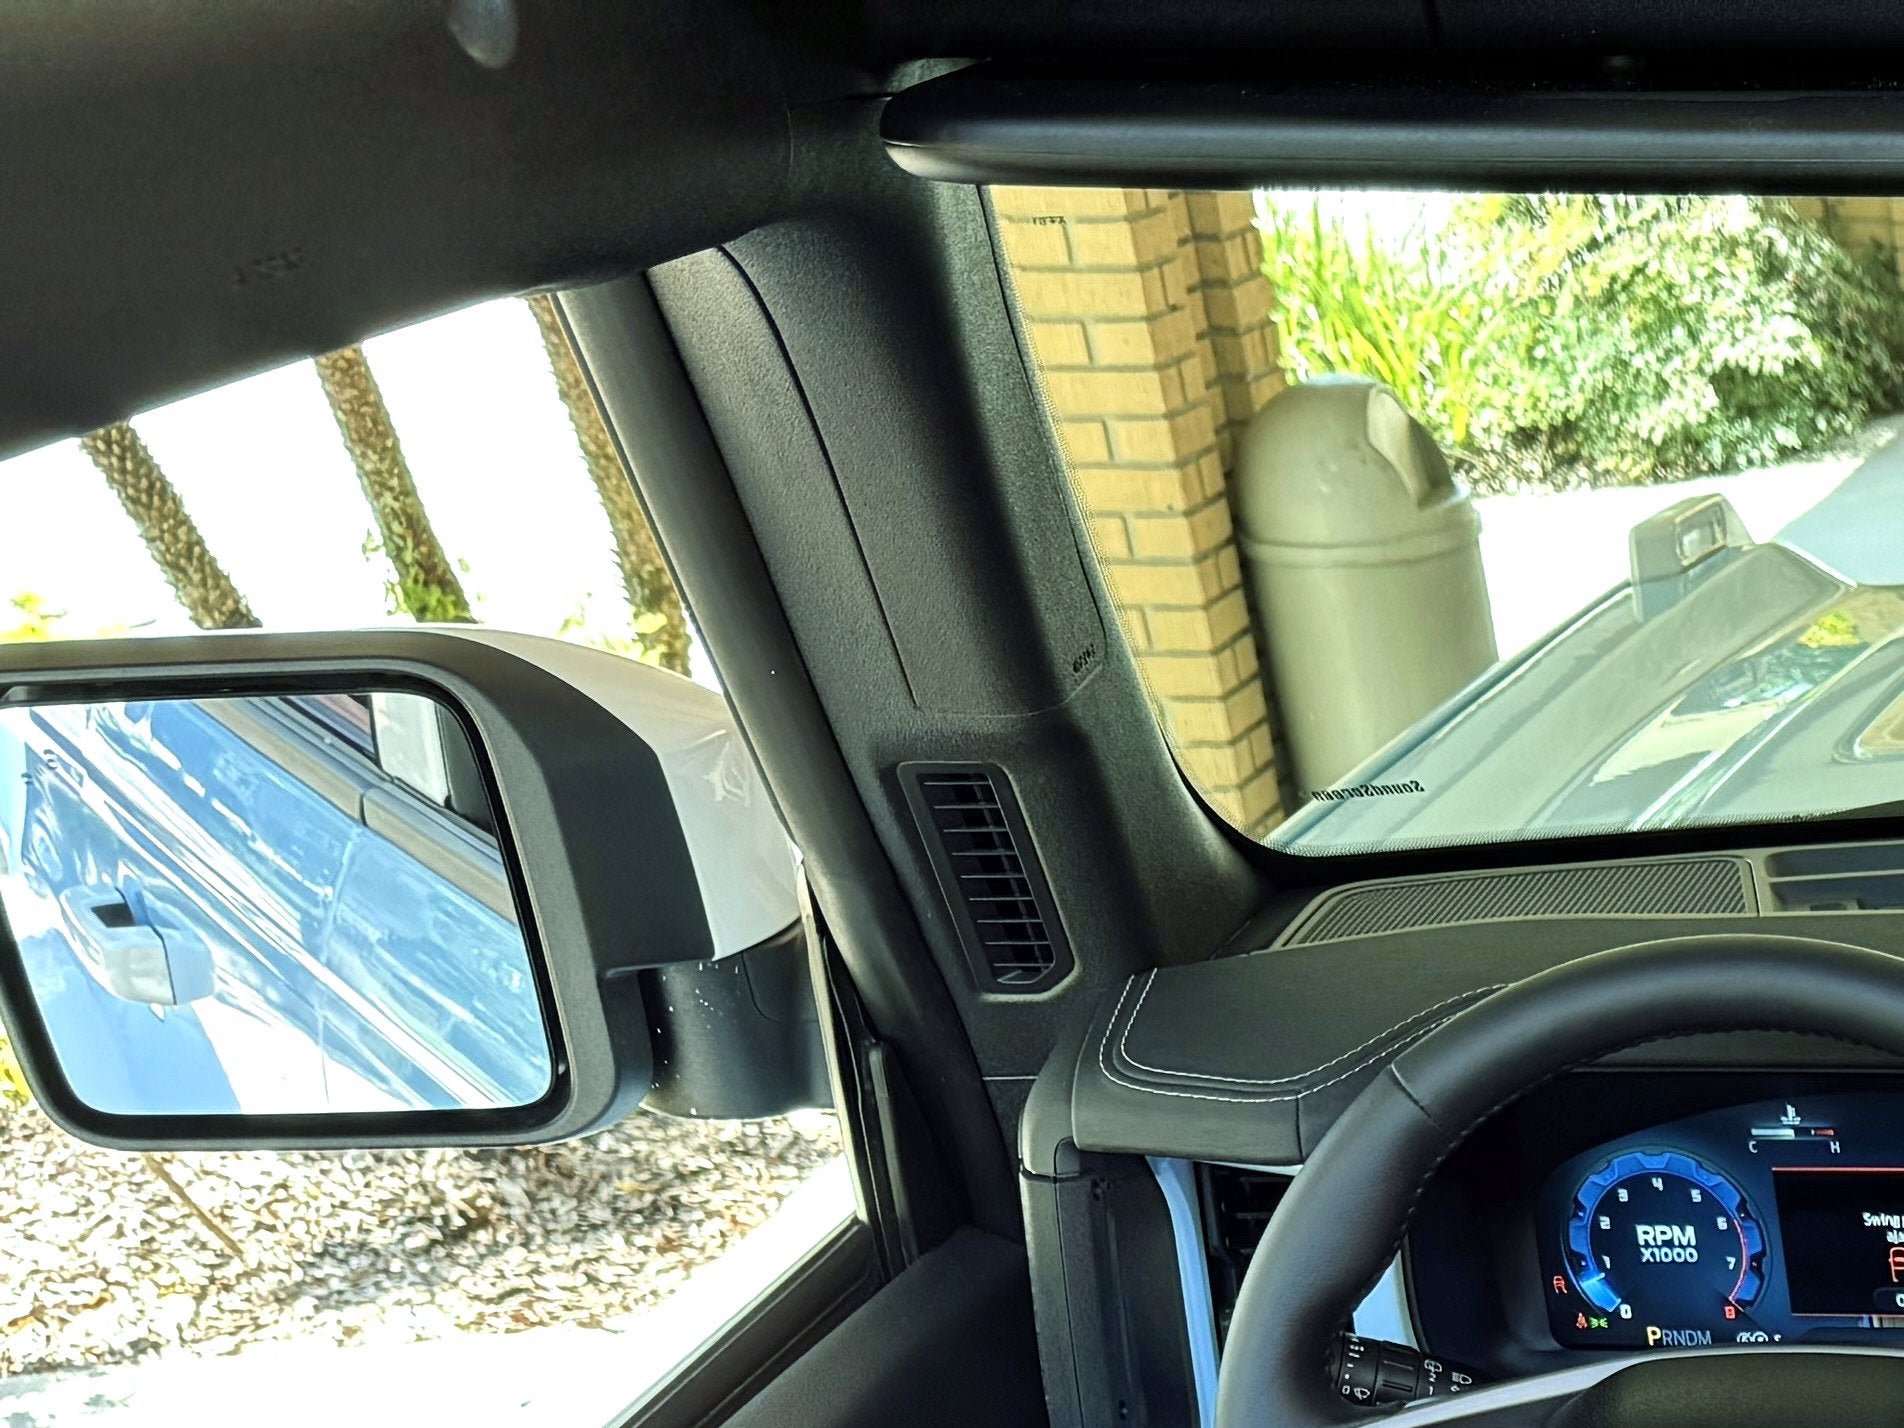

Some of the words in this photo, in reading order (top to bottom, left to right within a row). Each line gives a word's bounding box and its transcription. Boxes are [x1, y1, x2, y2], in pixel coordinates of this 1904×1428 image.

[1748, 1140, 1758, 1154] C
[1830, 1140, 1841, 1154] H
[1651, 1177, 1664, 1192] 4
[1617, 1188, 1629, 1203] 3
[1691, 1189, 1702, 1203] 5
[1599, 1216, 1611, 1230] 2
[1716, 1216, 1728, 1230] 6
[1862, 1211, 1901, 1230] Swing
[1636, 1225, 1696, 1246] RPM
[1602, 1254, 1611, 1269] 1
[1641, 1247, 1698, 1263] X1000
[1726, 1256, 1736, 1270] 7
[1619, 1303, 1633, 1320] 0
[1724, 1305, 1736, 1319] 8
